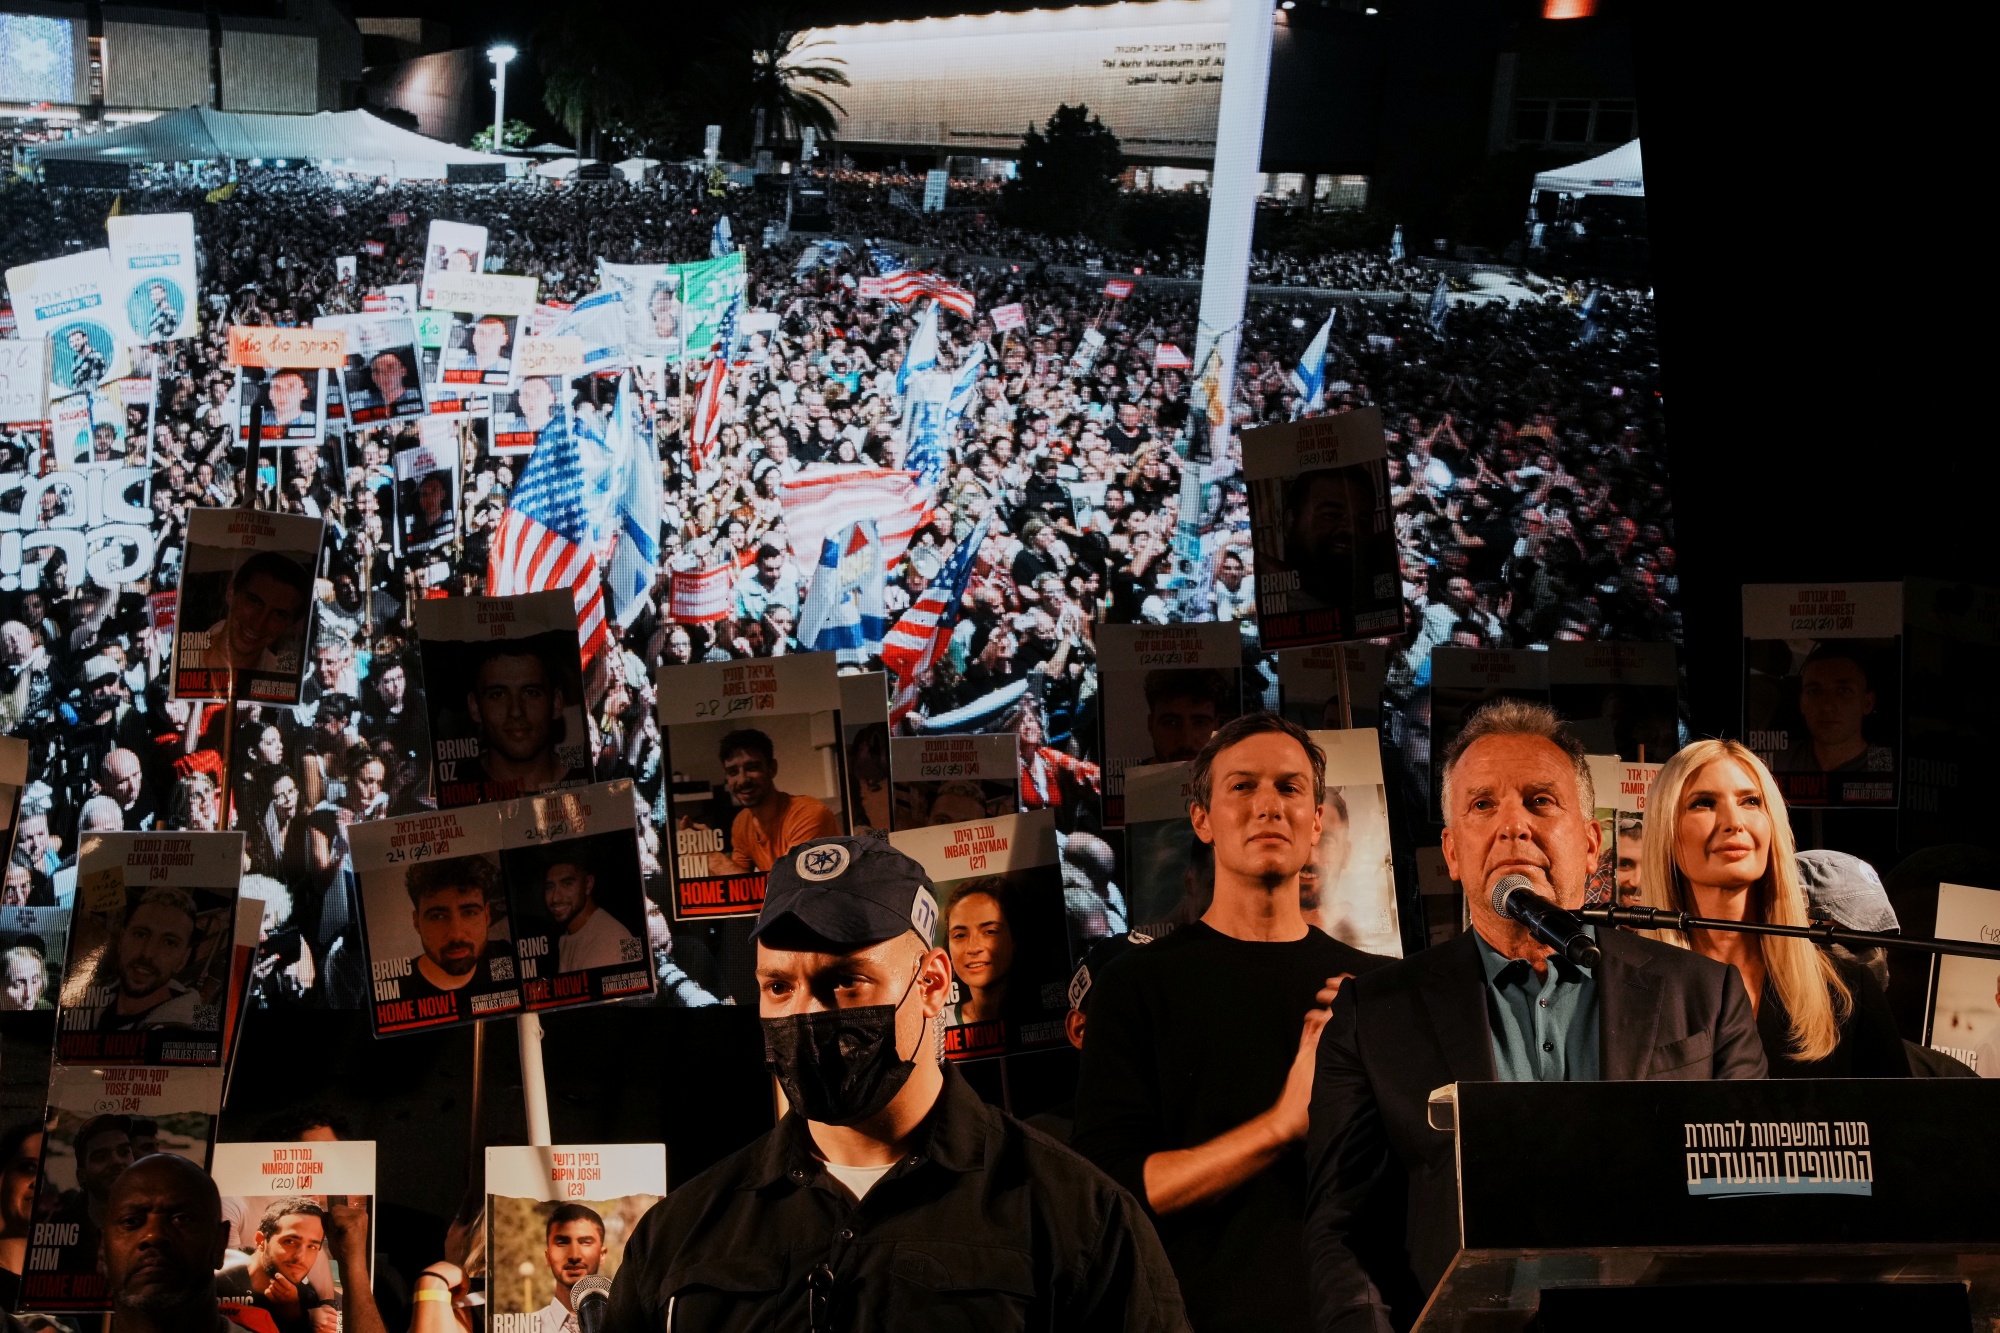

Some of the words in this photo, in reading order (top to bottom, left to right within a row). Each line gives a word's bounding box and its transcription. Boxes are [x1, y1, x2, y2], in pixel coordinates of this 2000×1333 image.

[1102, 59, 1116, 68] Tel
[1119, 59, 1141, 68] Aviv
[1146, 57, 1194, 68] Museum
[1198, 56, 1210, 66] of
[270, 334, 290, 352] סוף
[1314, 423, 1334, 437] איתן
[1296, 438, 1316, 454] EITAN
[1317, 436, 1339, 450] HORN
[1300, 452, 1320, 467] (38)
[228, 524, 249, 534] HADAR
[250, 524, 276, 537] GOLDIN
[242, 535, 256, 546] (32)
[1260, 570, 1300, 594] BRING
[1262, 593, 1288, 616] HIM
[1790, 604, 1816, 616] MATAN
[1818, 604, 1856, 616] ANGREST
[477, 613, 488, 624] OZ
[489, 612, 516, 623] DANIEL
[1264, 614, 1302, 639] HOME
[1304, 608, 1340, 634] NOW!
[1356, 618, 1380, 632] FAMILIES
[1380, 615, 1400, 628] FORUM
[1792, 618, 1813, 631] (22)
[180, 631, 211, 650] BRING
[1134, 641, 1149, 652] GUY
[1151, 639, 1204, 651] GILBOA-DALAL
[180, 650, 201, 669] HIM
[1470, 663, 1489, 672] MENY
[746, 664, 775, 678] אריאל
[178, 672, 208, 690] HOME
[250, 684, 274, 694] FAMILIES
[722, 682, 748, 698] ARIEL
[750, 679, 777, 694] CUNIO
[695, 699, 720, 718] 28
[436, 738, 480, 760] BRING
[1749, 730, 1788, 751] BRING
[921, 752, 948, 764] ELKANA
[950, 751, 978, 762] BOHBOT
[438, 761, 458, 783] OZ
[920, 764, 942, 776] (36)
[1626, 768, 1642, 781] אדר
[1907, 755, 1959, 788] BRING
[442, 781, 481, 804] HOME
[484, 776, 525, 801] NOW!
[1620, 782, 1645, 795] TAMIR
[1790, 772, 1828, 796] NOW!
[1842, 789, 1870, 800] FAMILIES
[1871, 789, 1893, 800] FORUM
[1906, 784, 1938, 813] HIM
[443, 814, 457, 827] גיא
[390, 834, 408, 848] GUY
[408, 826, 465, 846] GILBOA-DALAL
[954, 828, 973, 844] הימן
[974, 825, 994, 840] ענבר
[134, 840, 162, 852] בוחבוט
[164, 839, 192, 854] אלקנה
[676, 828, 724, 856] BRING
[944, 844, 970, 858] INBAR
[972, 838, 1008, 855] HAYMAN
[127, 853, 158, 866] ELKANA
[161, 854, 195, 866] BOHBOT
[386, 849, 405, 862] 24
[970, 854, 986, 870] (27)
[150, 866, 168, 881] (34)
[678, 854, 709, 879] HIM
[680, 881, 726, 906] HOME
[517, 936, 549, 958] RING
[372, 956, 412, 981] BRING
[374, 980, 400, 1002] HIM
[553, 970, 588, 997] NOW!
[602, 979, 628, 993] FAMILIES
[628, 976, 649, 990] FORUM
[492, 991, 500, 1000] AND
[377, 1000, 416, 1024] HOME
[418, 991, 457, 1018] NOW!
[472, 998, 498, 1013] FAMILIES
[499, 996, 520, 1008] FORUM
[63, 1009, 91, 1031] HIM
[964, 1020, 1007, 1048] NOW!
[1021, 1028, 1050, 1044] FAMILIES
[61, 1034, 101, 1056] HOME
[104, 1032, 146, 1056] NOW!
[162, 1049, 192, 1060] FAMILIES
[193, 1050, 217, 1060] FORUM
[102, 1068, 128, 1080] אוחנה
[129, 1068, 148, 1082] חיים
[150, 1069, 169, 1082] יוסף
[105, 1082, 131, 1096] YOSEF
[132, 1083, 162, 1096] OHANA
[94, 1098, 120, 1113] (25)
[122, 1096, 141, 1112] (24)
[1684, 1120, 1745, 1148] להחזרת
[1750, 1122, 1830, 1147] המשפחות
[1834, 1121, 1870, 1146] מטה
[273, 1149, 287, 1162] כהן
[289, 1148, 312, 1160] נמרוד
[553, 1153, 576, 1166] ג'ושי
[578, 1152, 600, 1167] ביפין
[262, 1162, 294, 1175] NIMROD
[296, 1162, 323, 1174] COHEN
[552, 1168, 575, 1181] BIPIN
[577, 1168, 601, 1180] JOSHI
[1686, 1151, 1780, 1185] והנעדרים
[1784, 1150, 1874, 1184] החטופים
[271, 1178, 295, 1191] (20)
[568, 1182, 586, 1197] (23)
[33, 1223, 80, 1246] BRING
[29, 1248, 60, 1270] HIM
[25, 1274, 70, 1298] HOME
[494, 1312, 541, 1333] BRING
